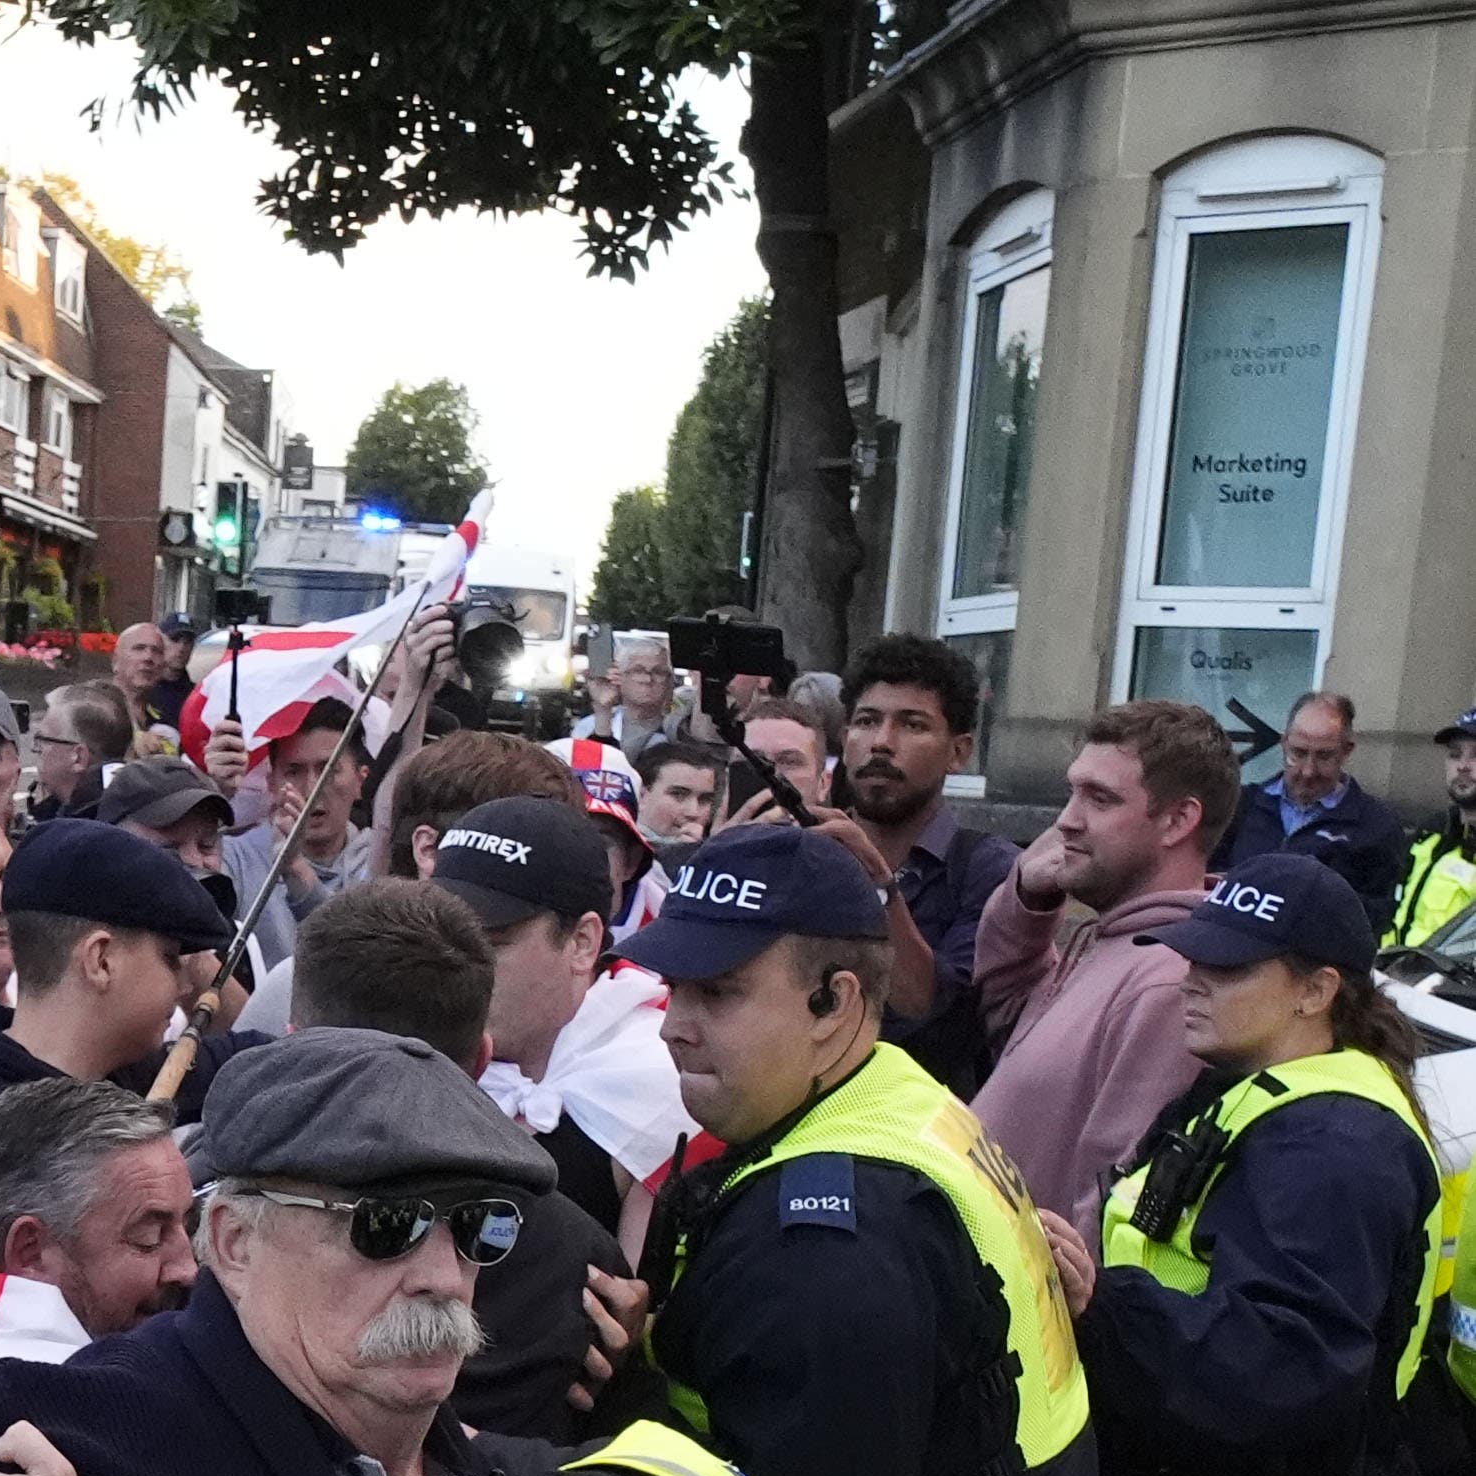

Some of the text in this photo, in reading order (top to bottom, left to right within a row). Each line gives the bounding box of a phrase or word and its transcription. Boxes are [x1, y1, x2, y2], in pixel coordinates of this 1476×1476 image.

[1191, 452, 1308, 478] Marketing
[1218, 483, 1275, 504] Suite
[1202, 880, 1286, 922] LICE
[789, 1195, 850, 1212] 80121
